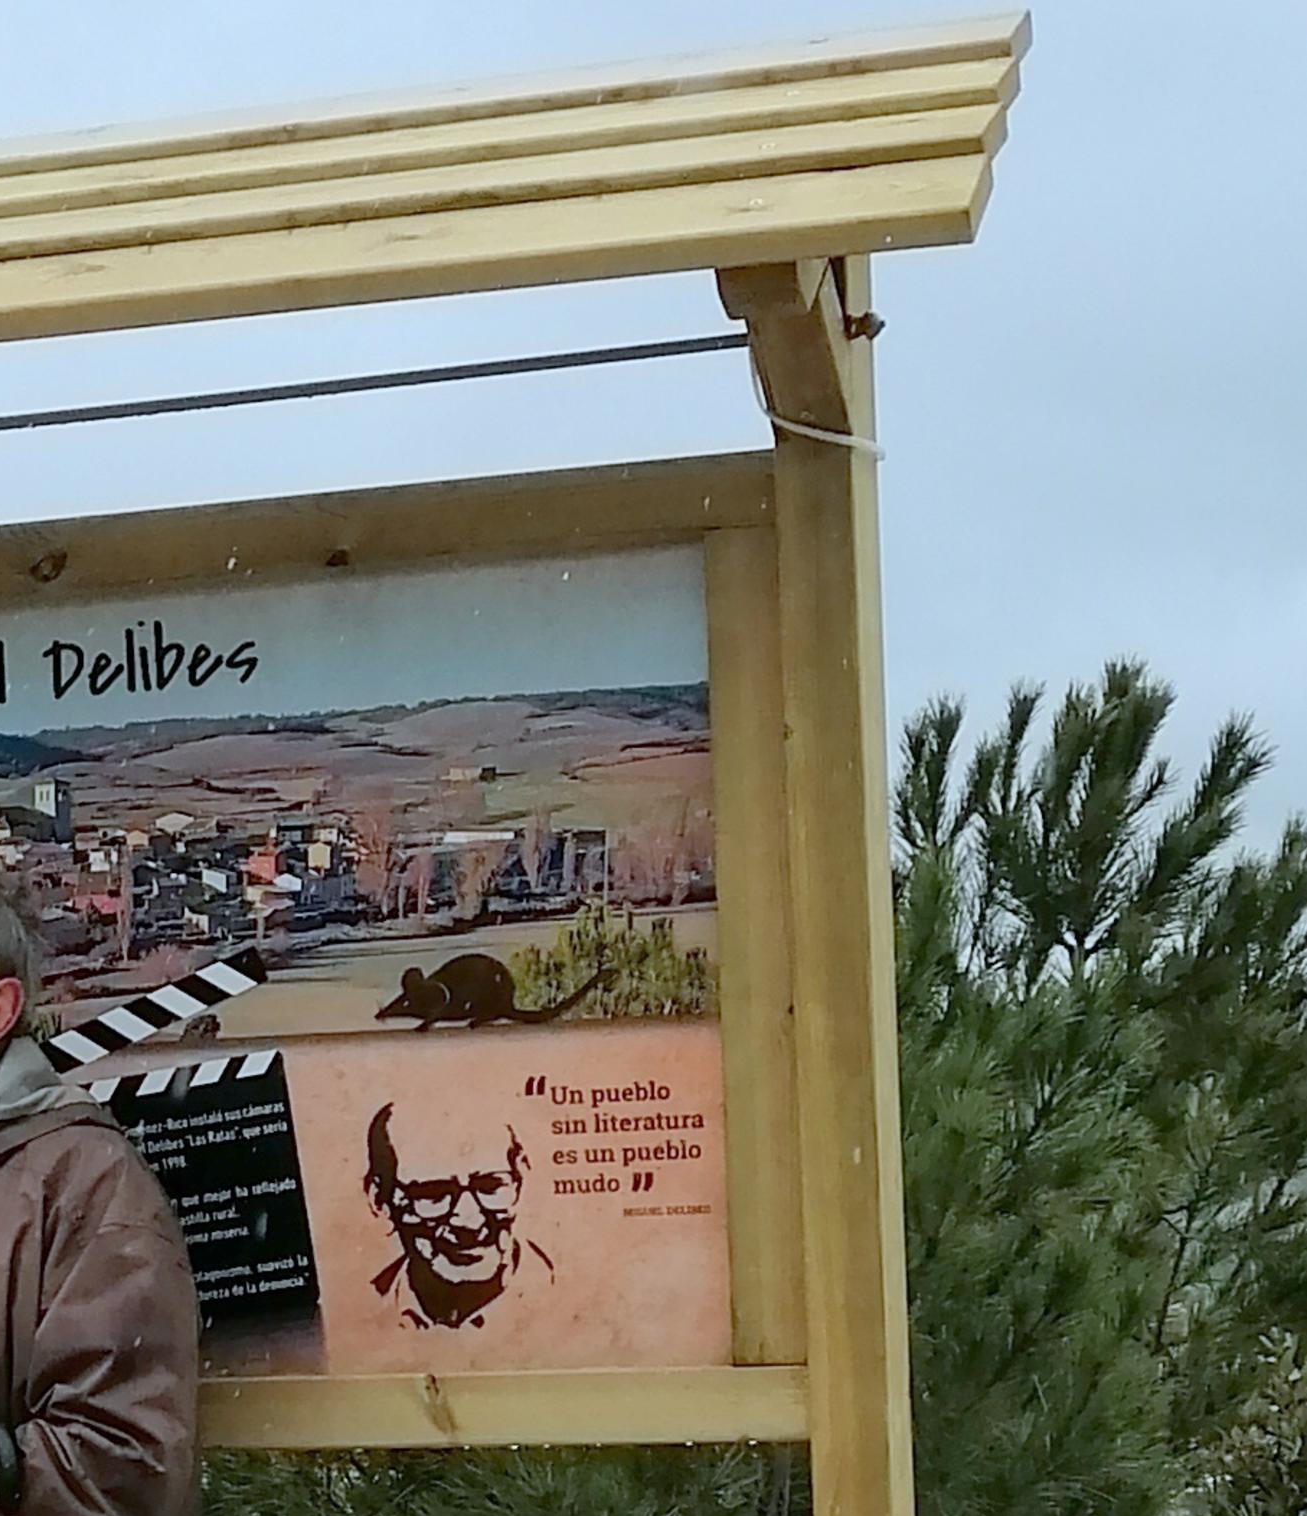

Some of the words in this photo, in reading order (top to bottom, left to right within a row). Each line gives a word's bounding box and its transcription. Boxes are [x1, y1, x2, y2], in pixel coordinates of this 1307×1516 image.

[45, 620, 260, 702] Delibes
[591, 1081, 671, 1108] pueblo
[224, 1109, 241, 1121] sus
[242, 1101, 285, 1118] cámaras
[551, 1115, 587, 1135] sin
[594, 1112, 704, 1134] literatura
[148, 1138, 184, 1154] Delibes
[552, 1149, 578, 1165] es
[584, 1147, 616, 1163] un
[622, 1139, 702, 1167] pueblo
[553, 1173, 621, 1195] mudo
[181, 1194, 199, 1208] que
[203, 1188, 232, 1203] mejor
[235, 1185, 248, 1198] ha
[297, 1254, 309, 1267] la
[231, 1284, 244, 1296] de
[246, 1281, 257, 1294] la
